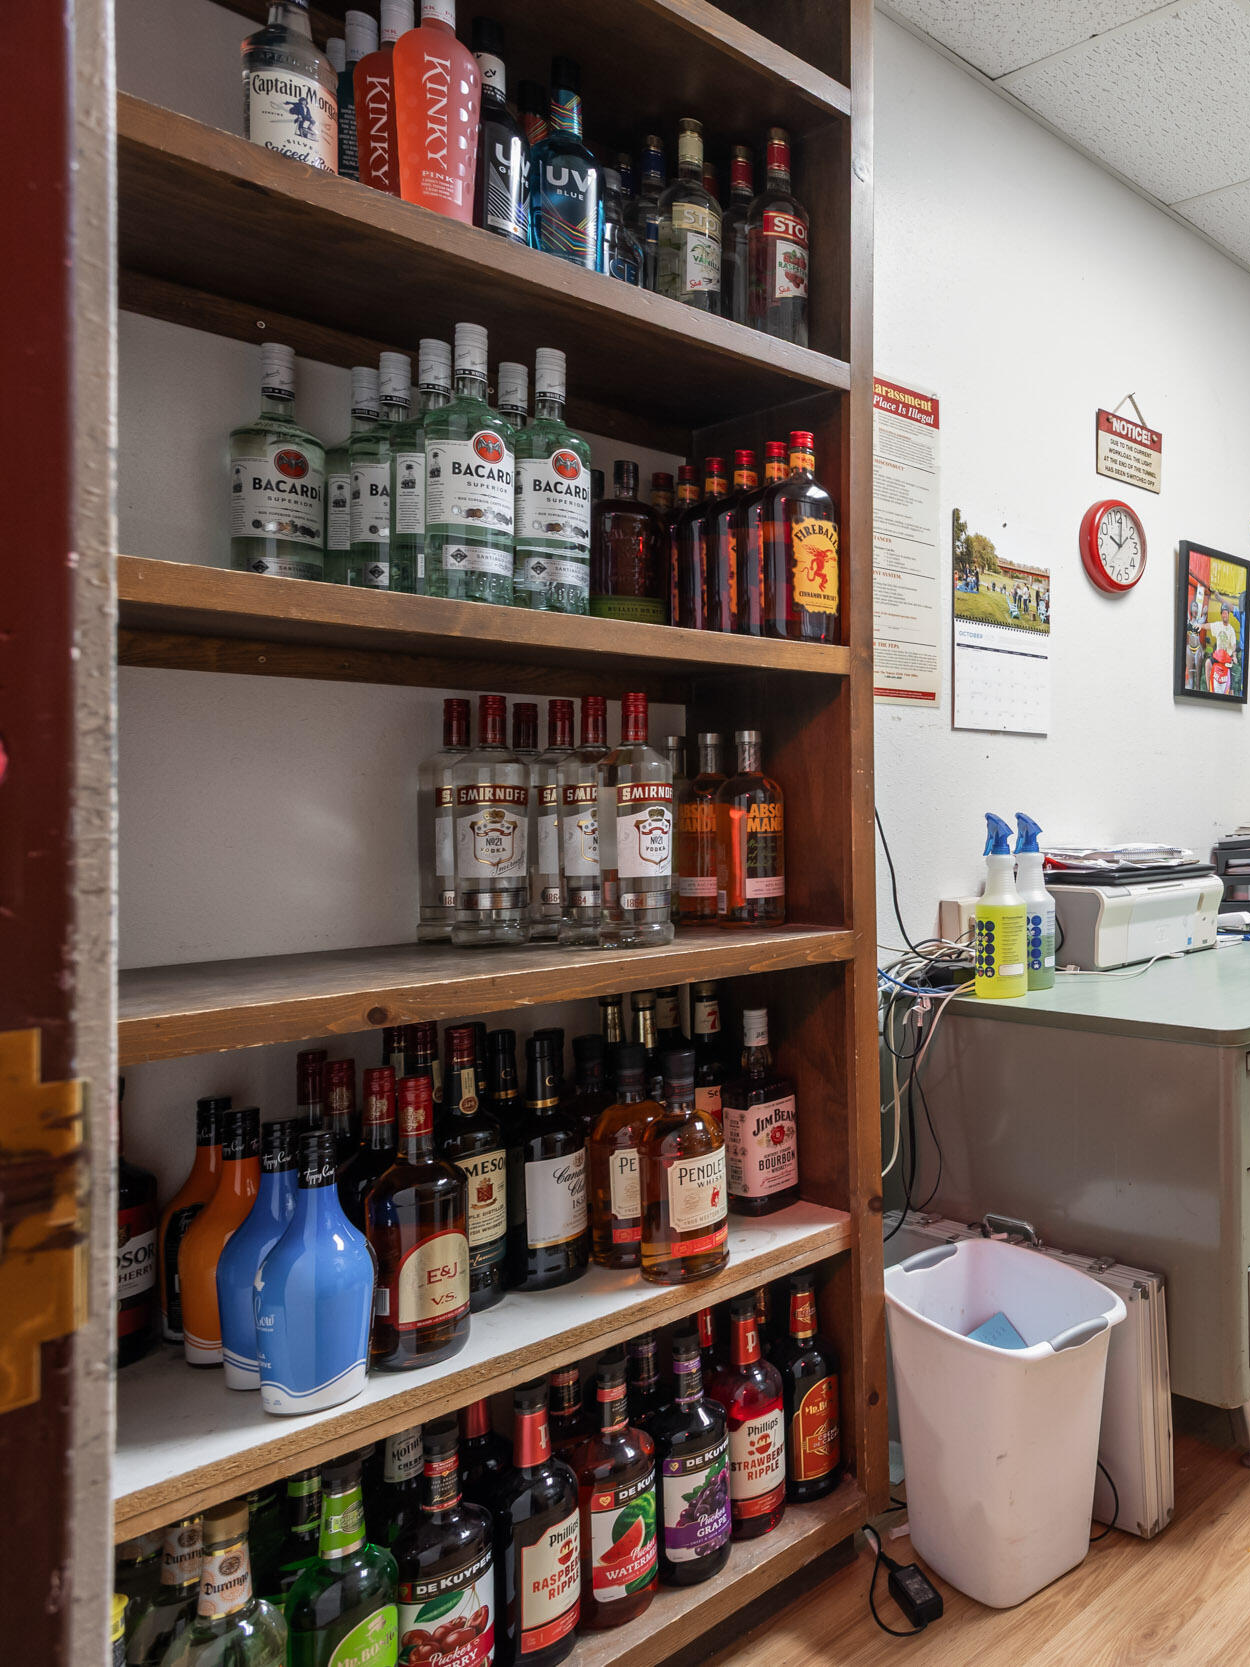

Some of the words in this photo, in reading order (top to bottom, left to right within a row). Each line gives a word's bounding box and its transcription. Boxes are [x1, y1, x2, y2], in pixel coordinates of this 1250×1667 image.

[252, 75, 302, 98] Captain
[302, 85, 338, 121] Morga
[422, 52, 450, 170] KINKY
[366, 75, 390, 186] KINKY
[422, 170, 455, 184] PINK
[546, 165, 596, 193] UV
[556, 188, 585, 201] BLUE
[683, 209, 722, 232] STOL
[774, 216, 809, 243] STOL
[873, 383, 933, 413] arassment
[874, 395, 897, 412] Place
[898, 403, 906, 415] Is
[908, 407, 935, 425] Illegal
[1112, 417, 1151, 446] NOTICE!
[1120, 441, 1126, 449] TO
[1126, 443, 1134, 452] THE
[1134, 447, 1152, 459] CURRENT
[1110, 457, 1118, 465] THE
[1118, 459, 1127, 468] END
[1127, 462, 1133, 470] OF
[1134, 465, 1142, 473] THE
[1142, 468, 1157, 479] TUNNEL
[1133, 456, 1141, 464] THE
[1141, 458, 1152, 468] LIGHT
[1104, 464, 1114, 473] HAS
[1114, 468, 1126, 477] BEEN
[1126, 471, 1147, 484] SWITCHED
[466, 481, 508, 494] SUPERIOR
[267, 495, 313, 508] SUPERIOR
[546, 497, 585, 509] SUPERIOR
[1107, 512, 1113, 525] 11
[1113, 510, 1122, 524] 12
[794, 524, 840, 553] FIREBALL
[1129, 526, 1135, 540] 2
[1132, 541, 1139, 555] 3
[1109, 565, 1115, 576] 7
[1116, 568, 1122, 581] 6
[1124, 567, 1130, 581] 5
[1129, 557, 1136, 570] 4
[958, 629, 983, 639] OCTOBER
[460, 788, 525, 801] SMIRNOFF
[567, 788, 598, 801] SMIR
[622, 785, 672, 801] SMIRNOF
[749, 803, 784, 818] ABSO
[706, 1010, 718, 1031] 7
[753, 1114, 773, 1137] JIM
[774, 1108, 797, 1122] BEAM
[465, 1156, 506, 1178] MESO
[678, 1156, 726, 1186] PENDLET
[759, 1151, 796, 1171] BOURBON
[552, 1165, 586, 1185] Cana
[697, 1173, 725, 1189] WHISK
[118, 1263, 154, 1284] HERRY
[426, 1261, 459, 1286] E&J
[431, 1291, 457, 1306] V.S.
[747, 1416, 780, 1437] Phillips
[686, 1456, 704, 1468] DE
[704, 1438, 729, 1462] KUYP
[731, 1445, 785, 1473] STRAWBER
[619, 1487, 637, 1500] DE
[637, 1466, 656, 1494] KUY
[747, 1464, 780, 1482] RIPPLE
[549, 1517, 580, 1548] Phillips
[697, 1517, 728, 1538] GRAPE
[165, 1548, 203, 1566] Durang
[605, 1545, 658, 1582] WATERM
[204, 1571, 250, 1596] Durango
[416, 1583, 438, 1596] DE
[440, 1550, 493, 1590] KUYPER
[548, 1572, 580, 1601] RIPPLE
